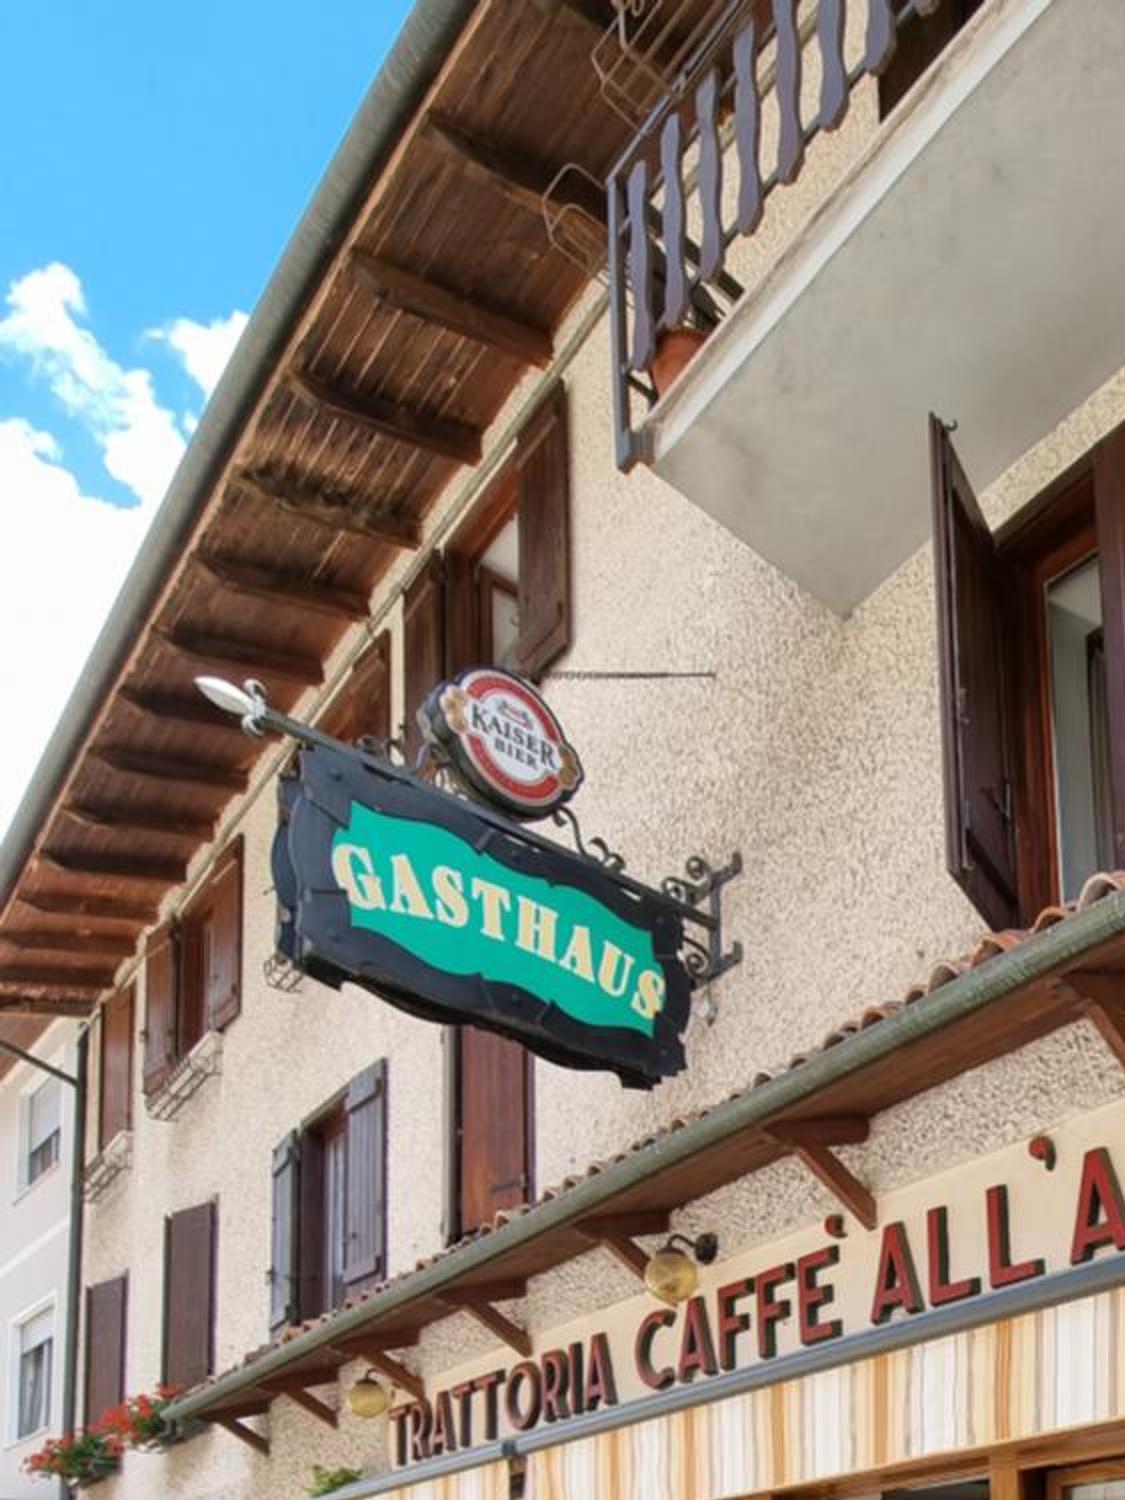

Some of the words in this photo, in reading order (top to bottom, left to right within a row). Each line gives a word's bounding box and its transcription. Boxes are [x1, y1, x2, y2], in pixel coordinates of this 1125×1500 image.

[472, 704, 556, 769] KAISER
[495, 738, 538, 770] BIER
[331, 843, 667, 1020] GASTHAUS
[390, 1332, 618, 1466] TRATTORIA
